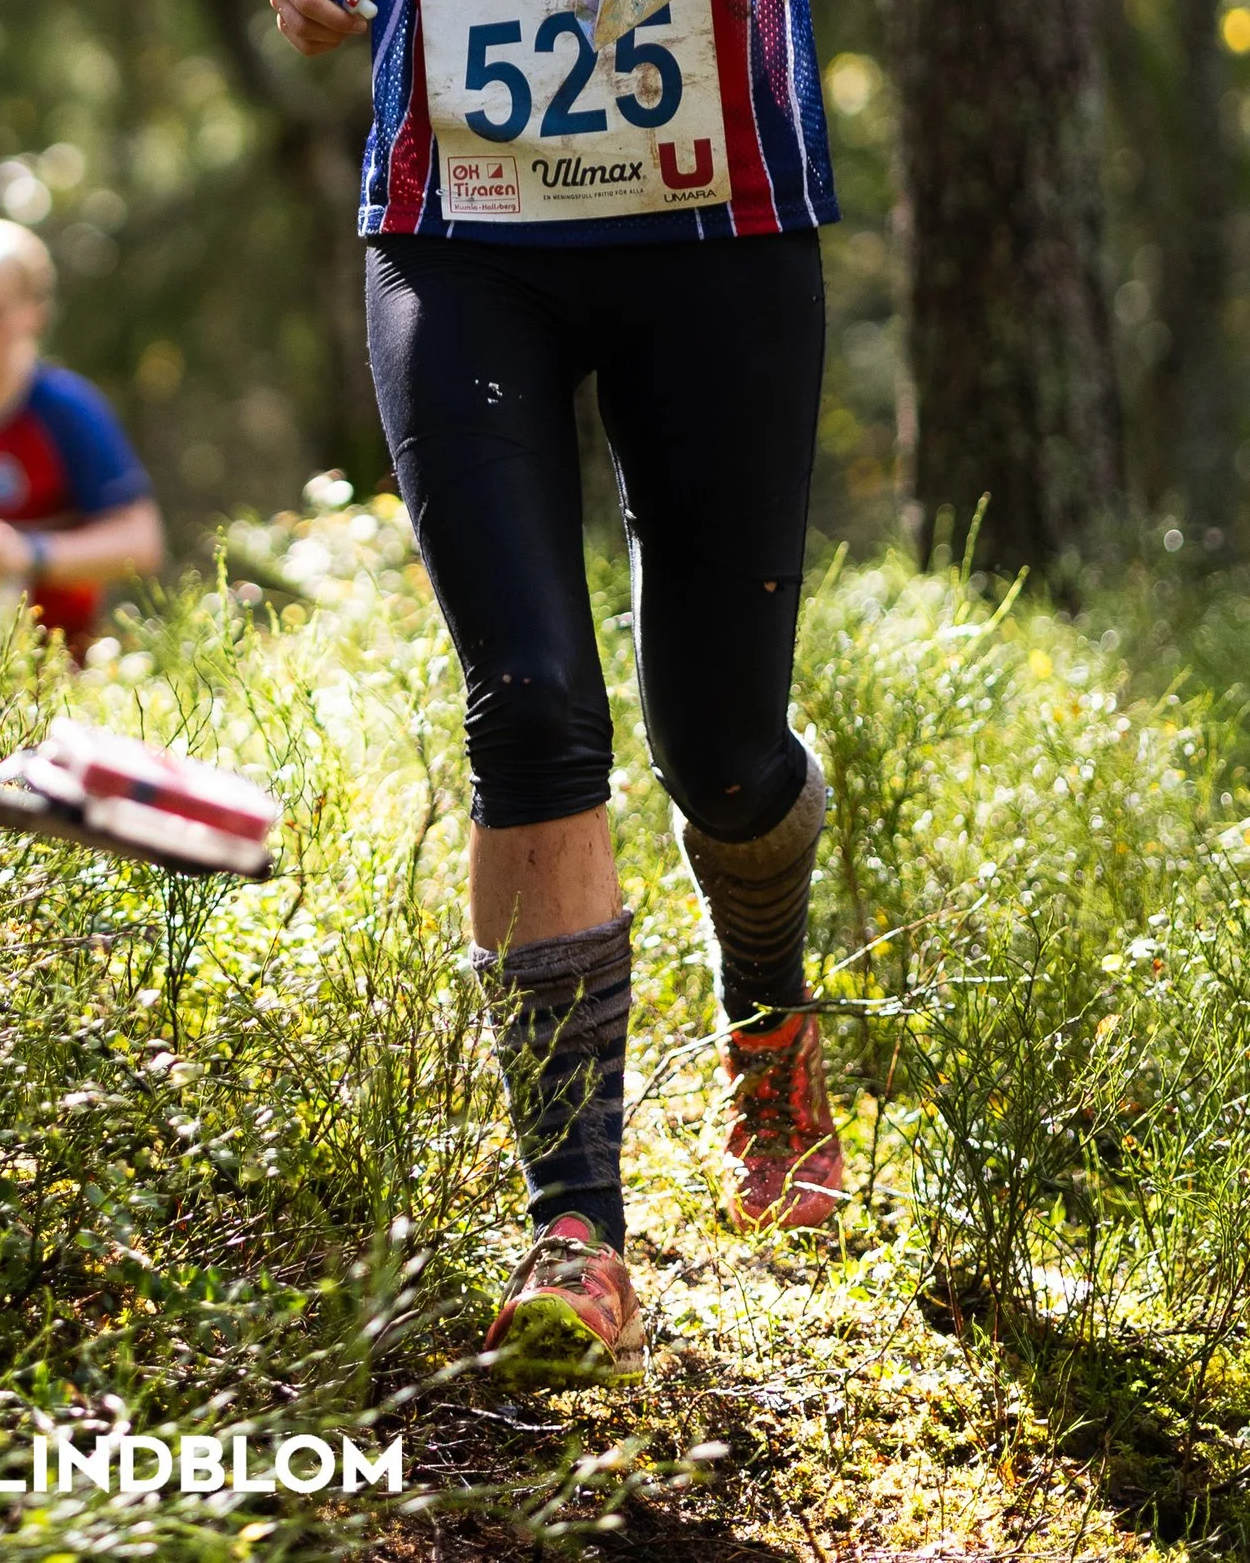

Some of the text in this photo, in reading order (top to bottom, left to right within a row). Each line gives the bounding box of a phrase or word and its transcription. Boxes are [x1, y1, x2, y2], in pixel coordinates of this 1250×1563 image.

[464, 4, 684, 143] 525
[531, 157, 643, 188] Ullmax
[454, 182, 517, 197] Tisaren
[663, 189, 717, 202] UMARA
